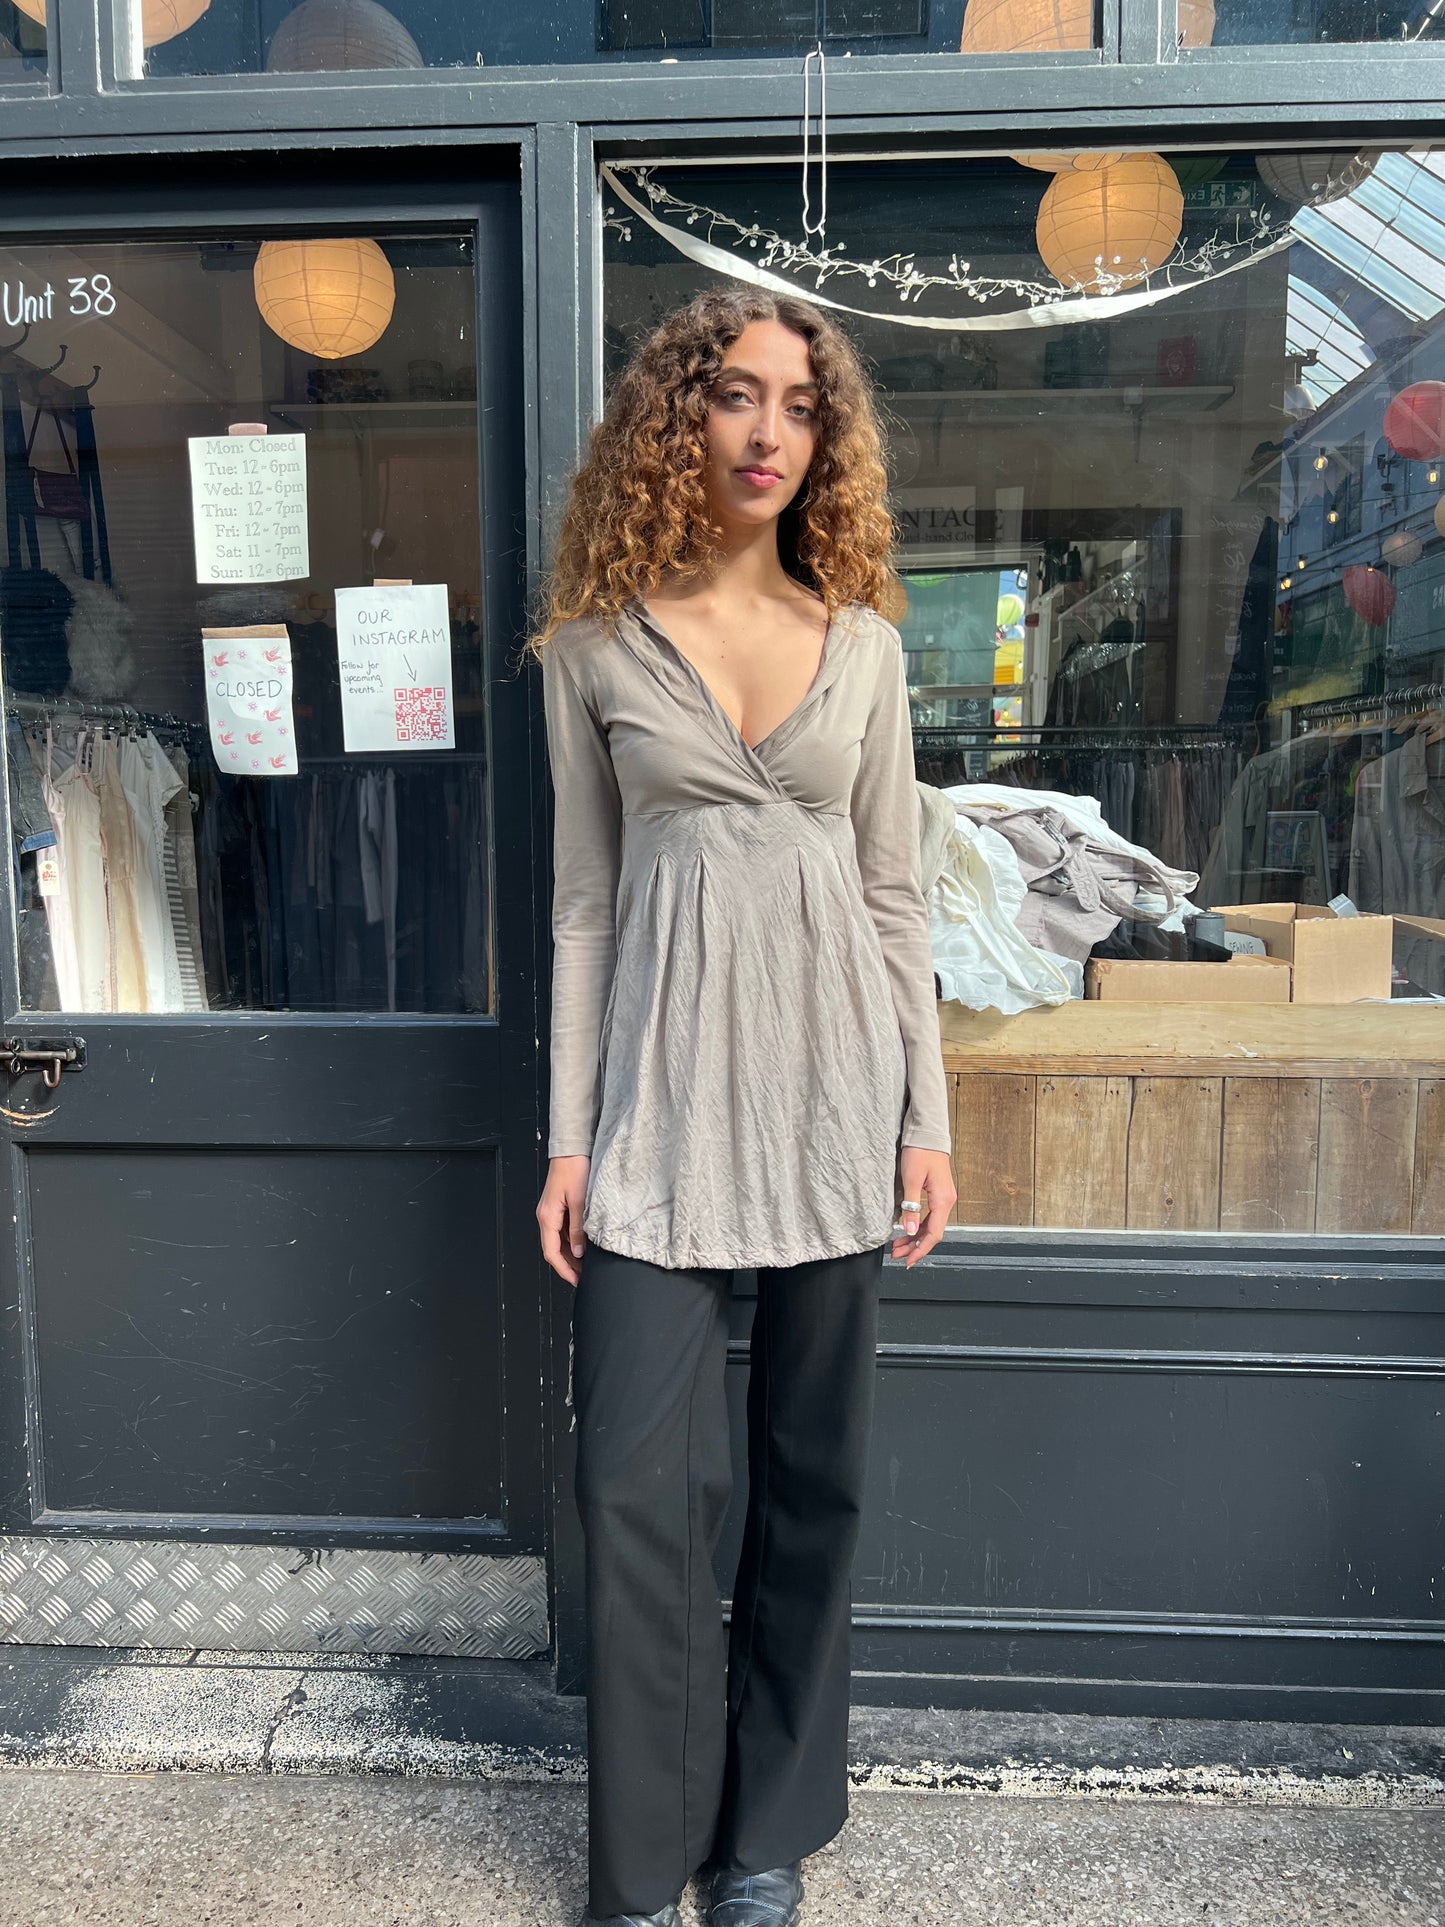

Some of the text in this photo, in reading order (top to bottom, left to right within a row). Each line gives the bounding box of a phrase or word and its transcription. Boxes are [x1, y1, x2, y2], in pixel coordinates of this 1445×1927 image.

[3, 273, 116, 326] Unit 38
[206, 438, 296, 455] Mon: Closed
[204, 461, 238, 476] Tue:
[203, 482, 243, 496] Wed:
[201, 503, 237, 517] Thu:
[215, 524, 240, 538] Fri:
[216, 544, 242, 558] Sat:
[210, 564, 243, 579] Sun:
[357, 608, 393, 625] OUR
[352, 627, 446, 646] INSTAGRAM
[341, 659, 381, 675] Follow for
[344, 673, 384, 688] upcoming
[215, 679, 283, 698] CLOSED
